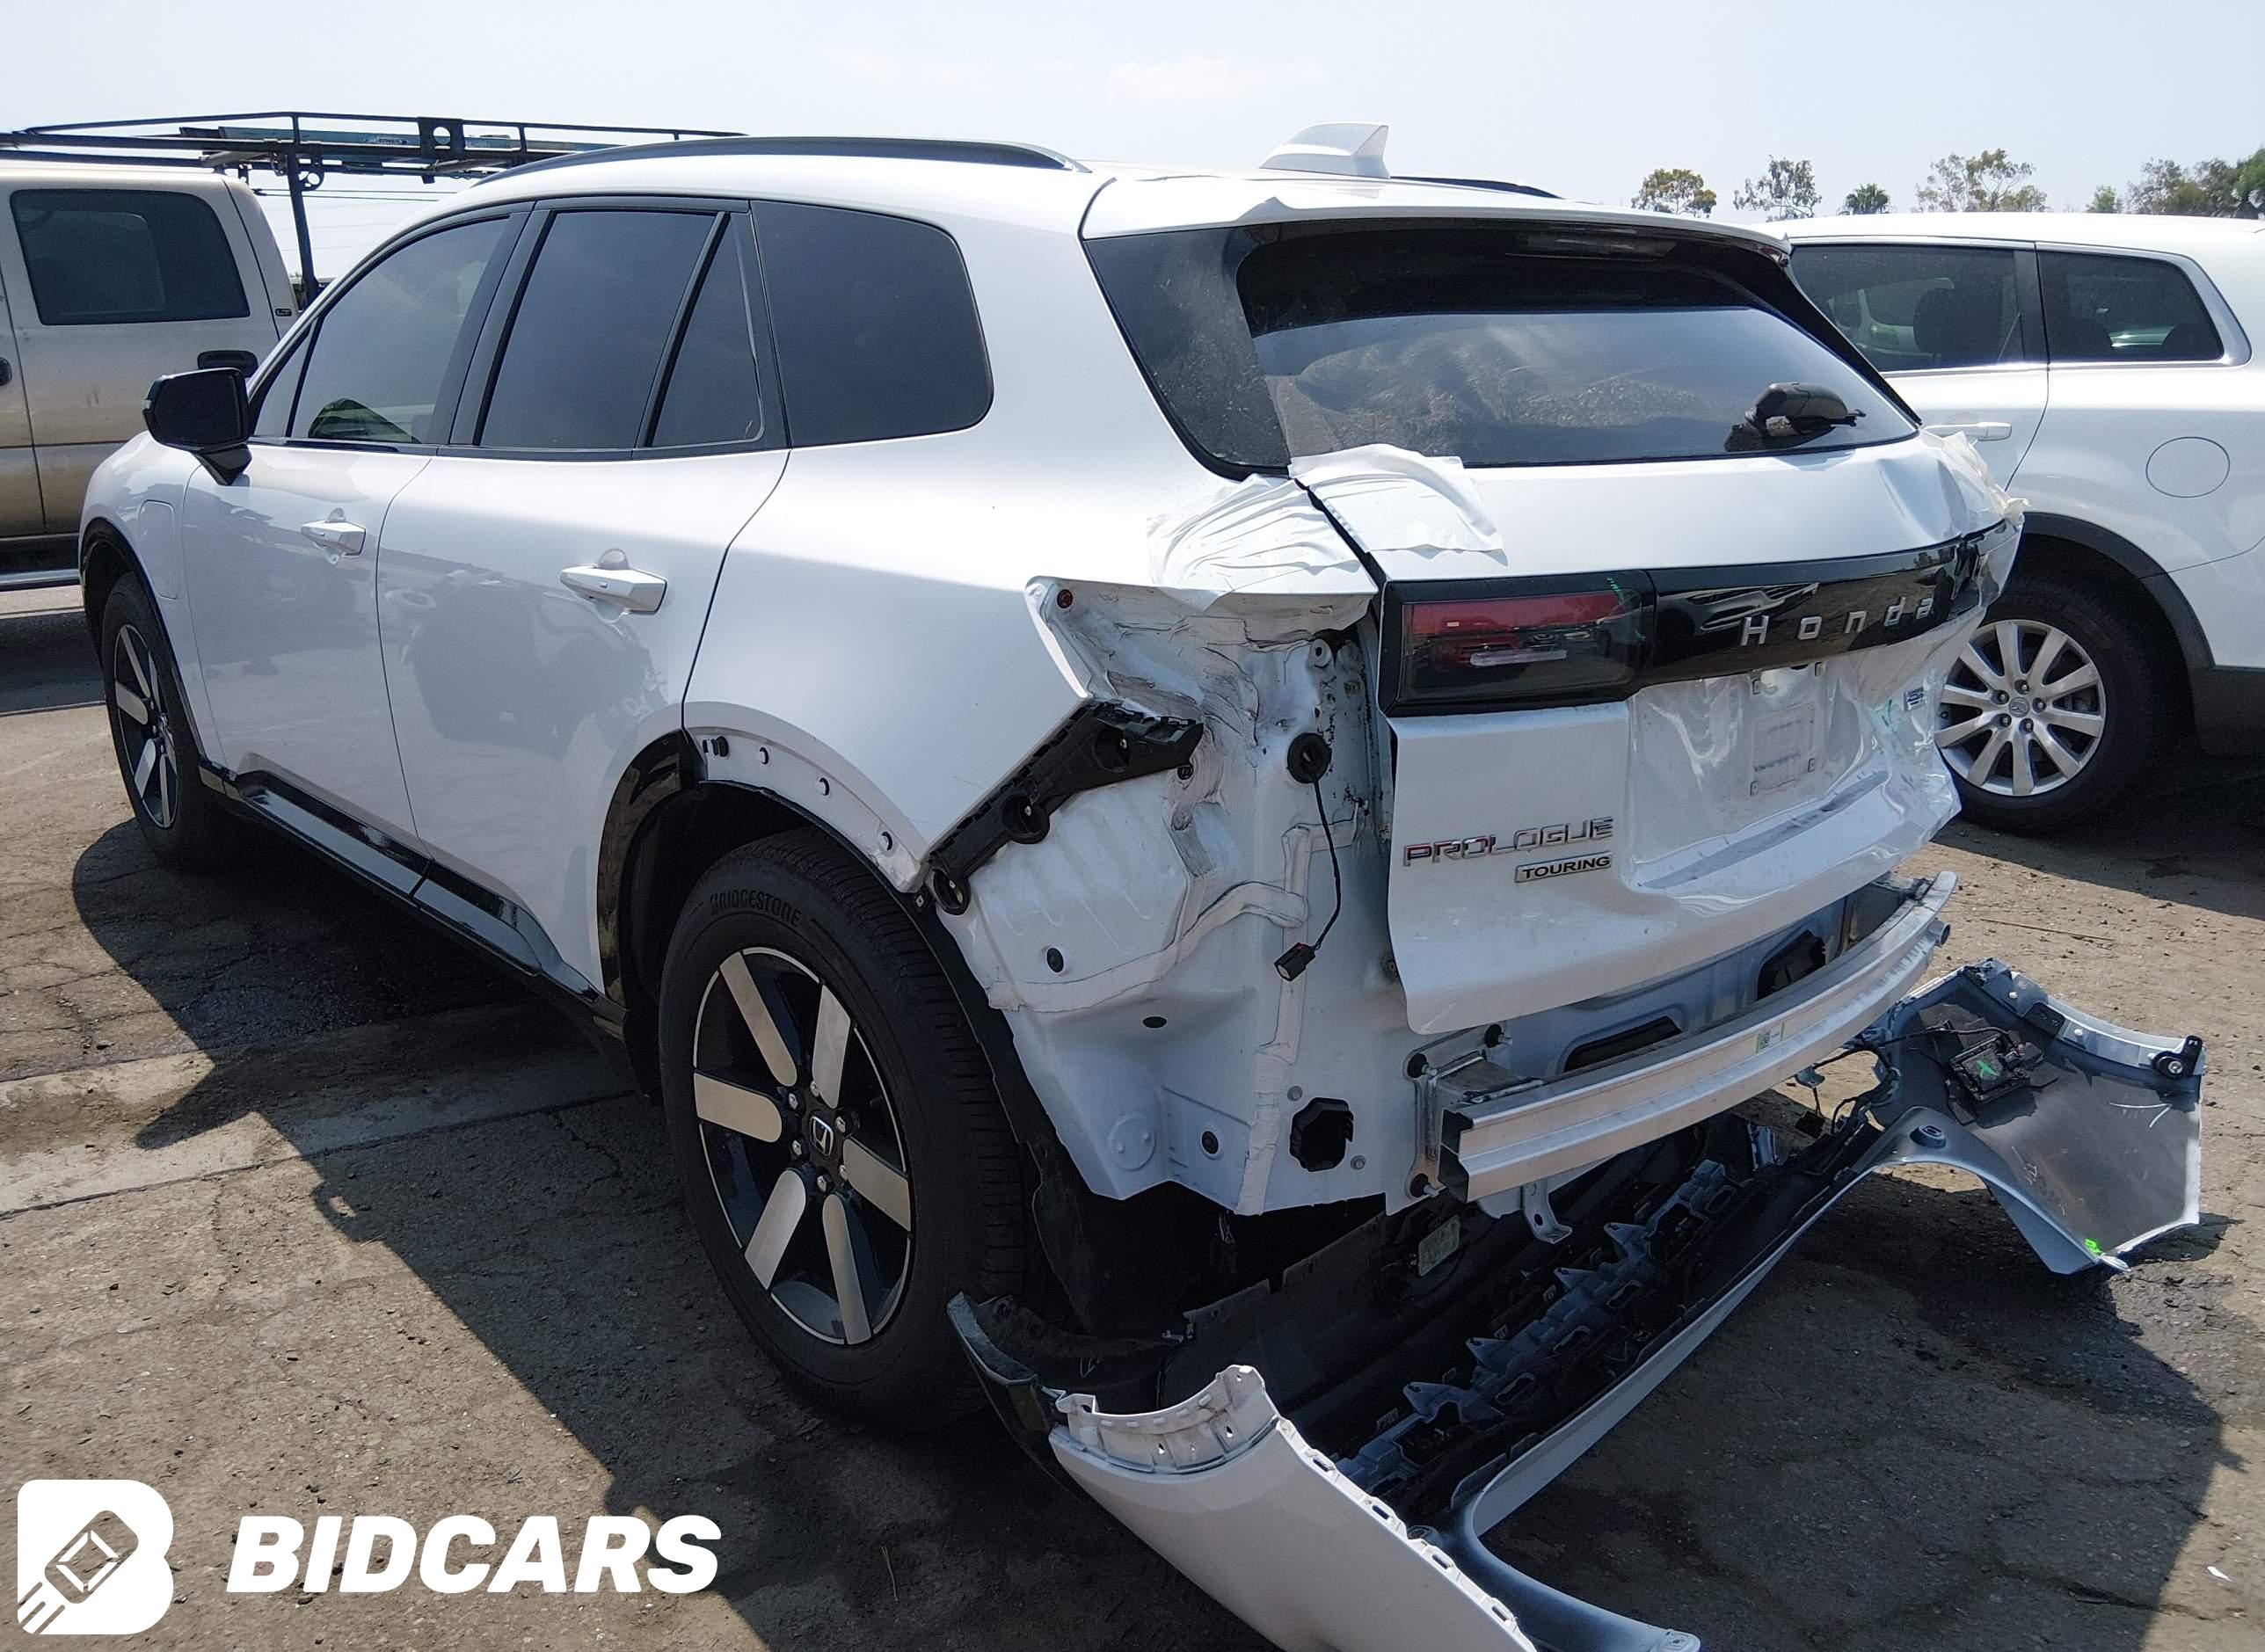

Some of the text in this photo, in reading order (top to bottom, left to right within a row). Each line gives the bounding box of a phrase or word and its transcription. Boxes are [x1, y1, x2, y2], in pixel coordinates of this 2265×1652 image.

[1740, 596, 1933, 646] Honda
[1403, 816, 1613, 867] PROLOGUE
[1523, 856, 1610, 878] TOURING
[710, 889, 802, 927] BRIDGESTONE
